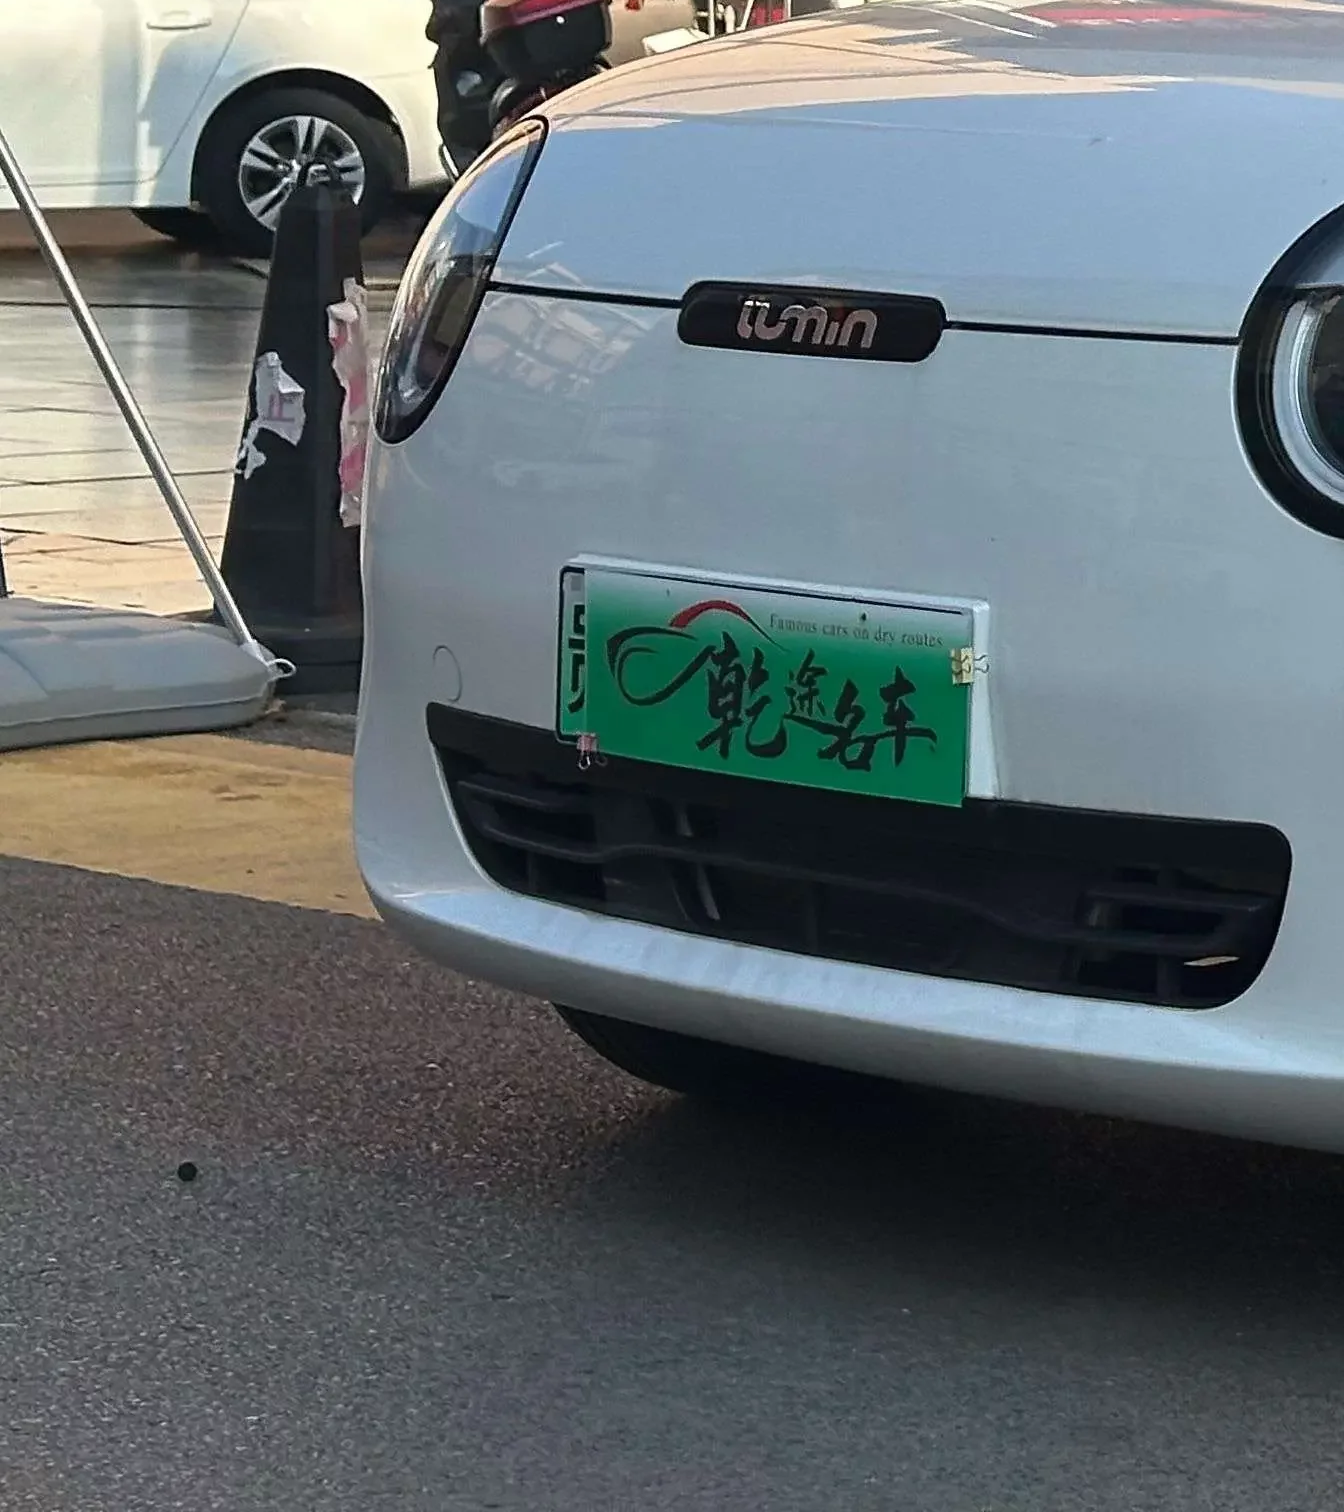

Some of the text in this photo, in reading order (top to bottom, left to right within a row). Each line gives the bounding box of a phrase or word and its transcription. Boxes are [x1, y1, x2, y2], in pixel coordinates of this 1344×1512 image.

[770, 613, 944, 649] Famous cars on dry routes
